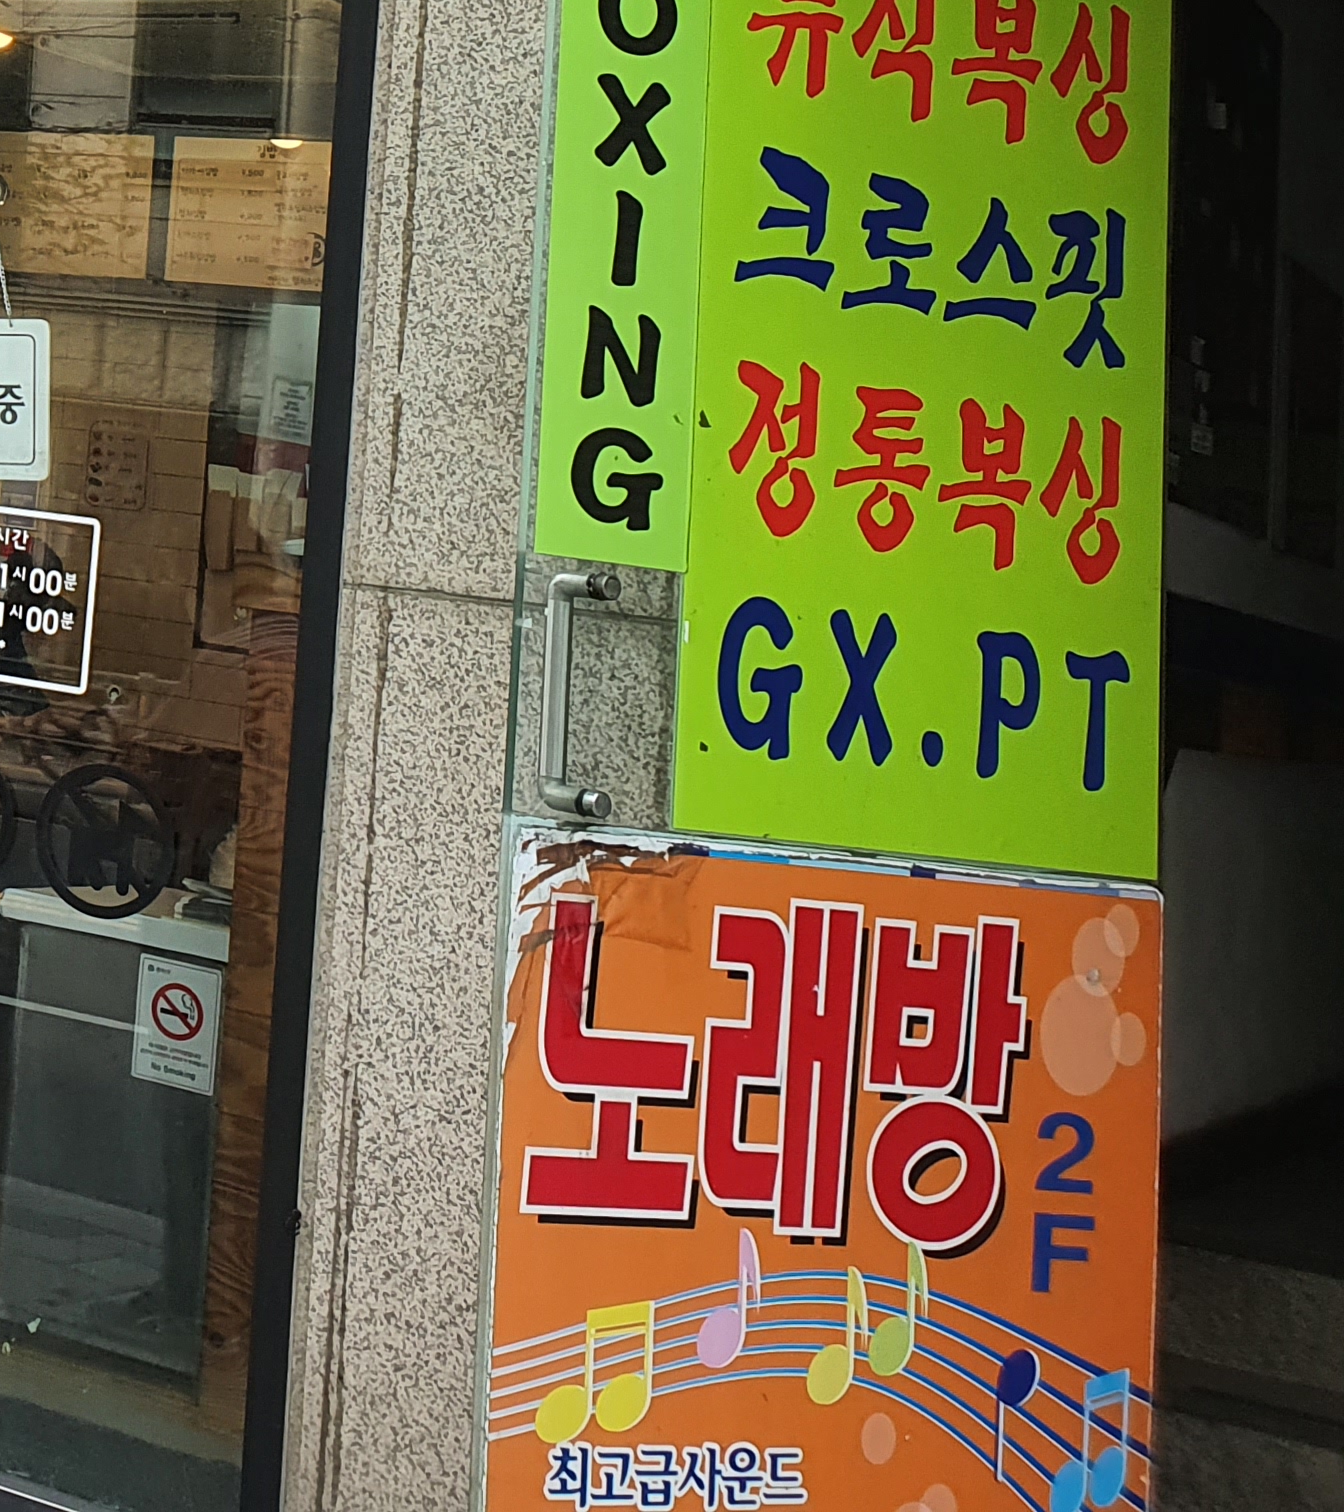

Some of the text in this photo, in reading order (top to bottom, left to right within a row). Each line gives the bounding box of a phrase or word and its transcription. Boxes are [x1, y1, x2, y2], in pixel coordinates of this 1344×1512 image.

[734, 145, 1127, 370] 크로스핏
[727, 359, 1123, 586] 정통복싱
[717, 595, 1132, 792] GX.PT
[519, 891, 1030, 1259] 노래방
[543, 1439, 810, 1512] 최고급사운드
